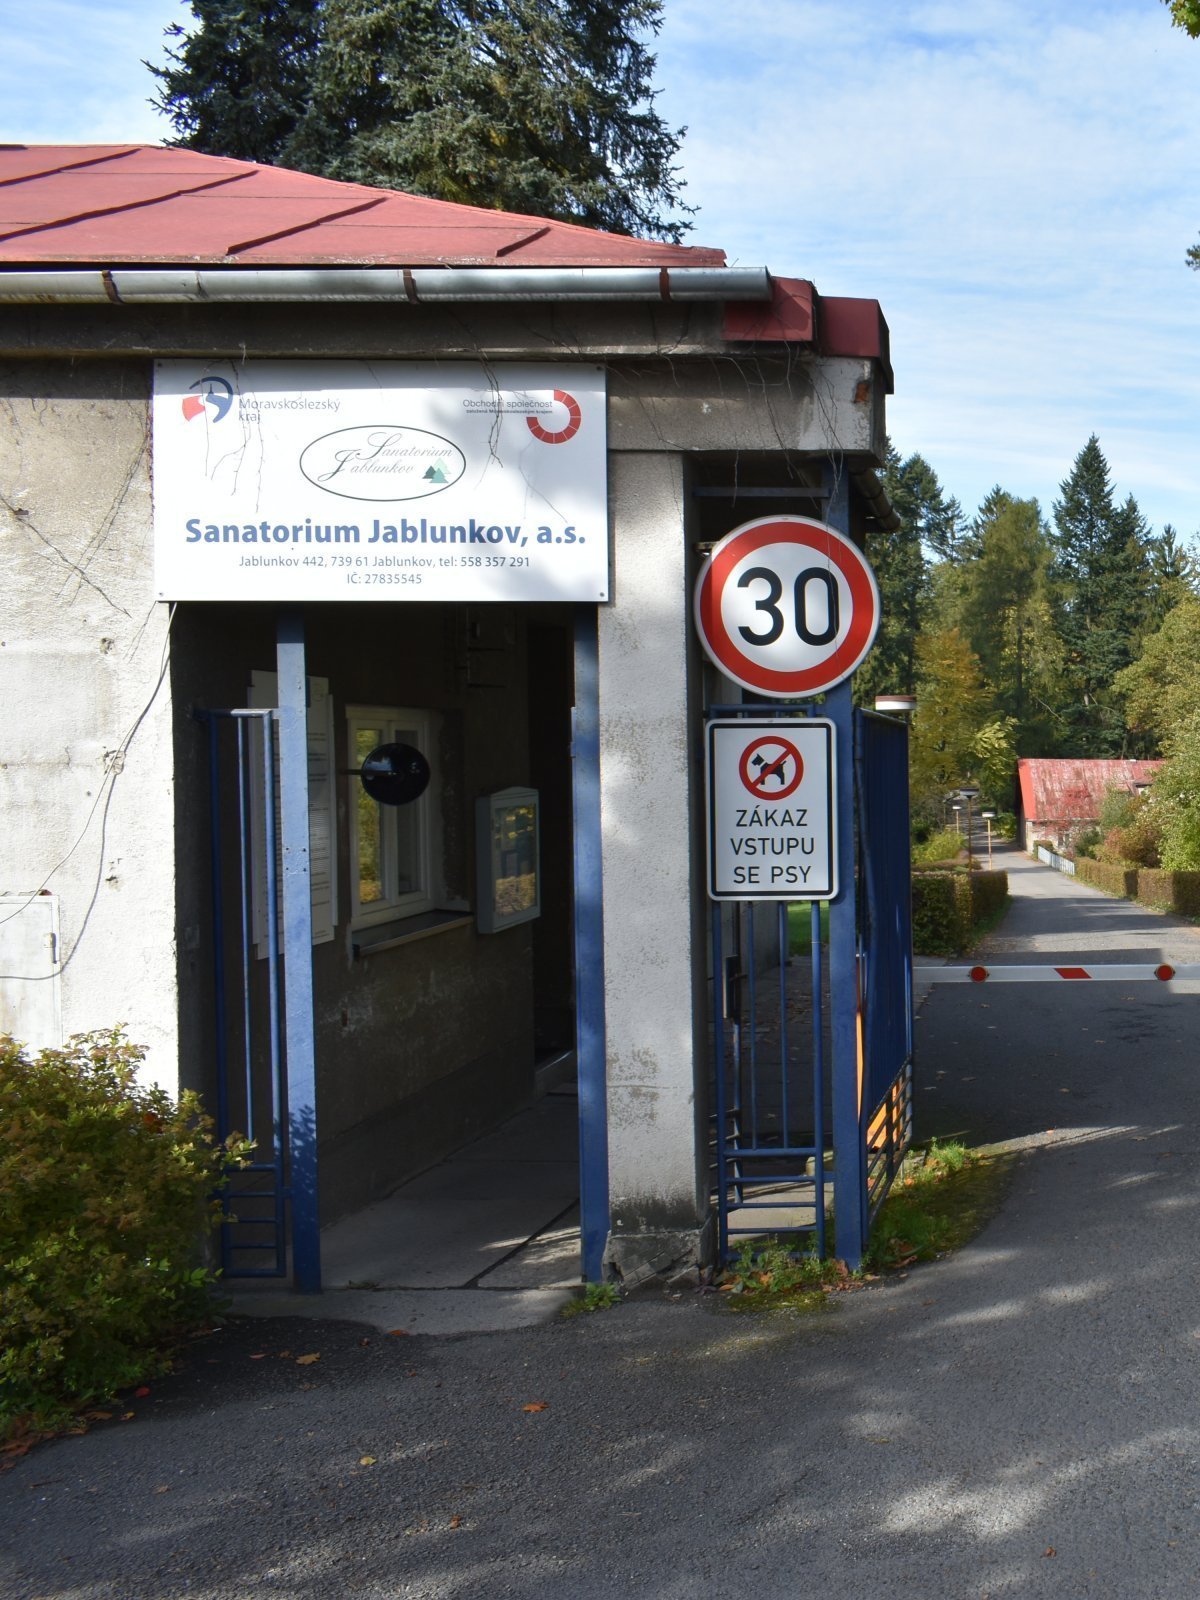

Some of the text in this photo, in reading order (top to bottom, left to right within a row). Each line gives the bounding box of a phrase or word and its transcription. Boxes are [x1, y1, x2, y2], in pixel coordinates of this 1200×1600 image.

[238, 398, 341, 413] Moravskoslezský
[506, 399, 553, 410] společnost
[238, 411, 261, 424] kraj
[355, 431, 453, 460] Sanatorium
[317, 449, 415, 482] Jablunkov
[185, 518, 586, 548] Sanatorium Jablunkov, a.s.
[238, 555, 530, 569] Jablunkov 442, 739 61 Jablunkov, tel: 558 357 291
[346, 571, 422, 584] IČ: 27835545
[737, 566, 839, 646] 30
[736, 805, 808, 828] ZÁKAZ
[730, 837, 815, 856] VSTUPU
[733, 865, 812, 884] SE PSY
